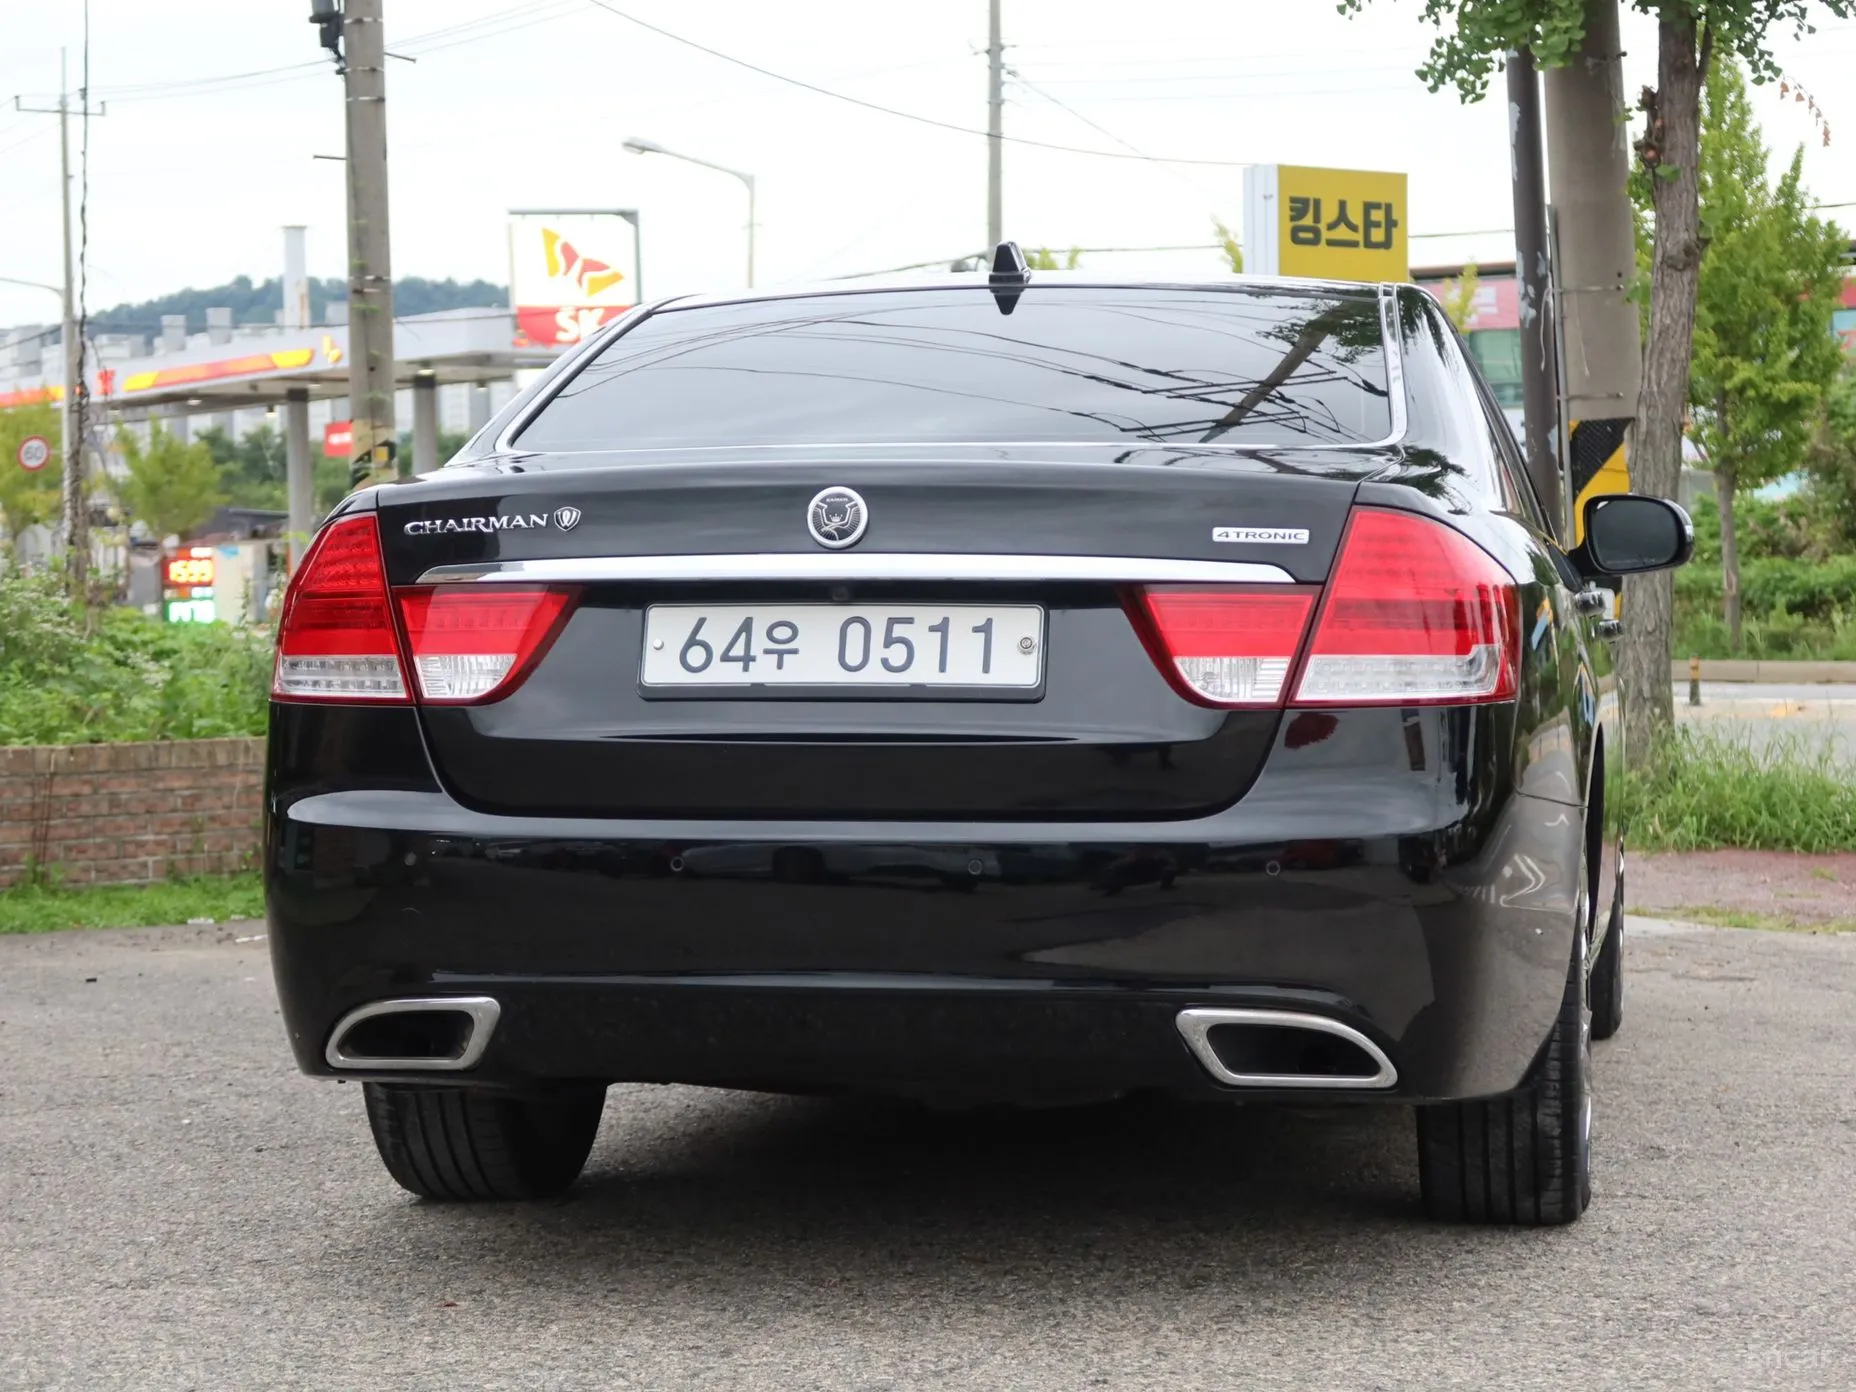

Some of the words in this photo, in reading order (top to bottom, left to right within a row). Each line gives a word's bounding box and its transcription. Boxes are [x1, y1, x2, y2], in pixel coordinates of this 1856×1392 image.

[1288, 195, 1398, 250] 킹스타
[555, 308, 604, 342] SK
[403, 513, 549, 536] CHAIRMAN
[1216, 530, 1306, 541] 4TRONIC
[679, 615, 800, 674] 64우
[837, 615, 994, 674] 0511
